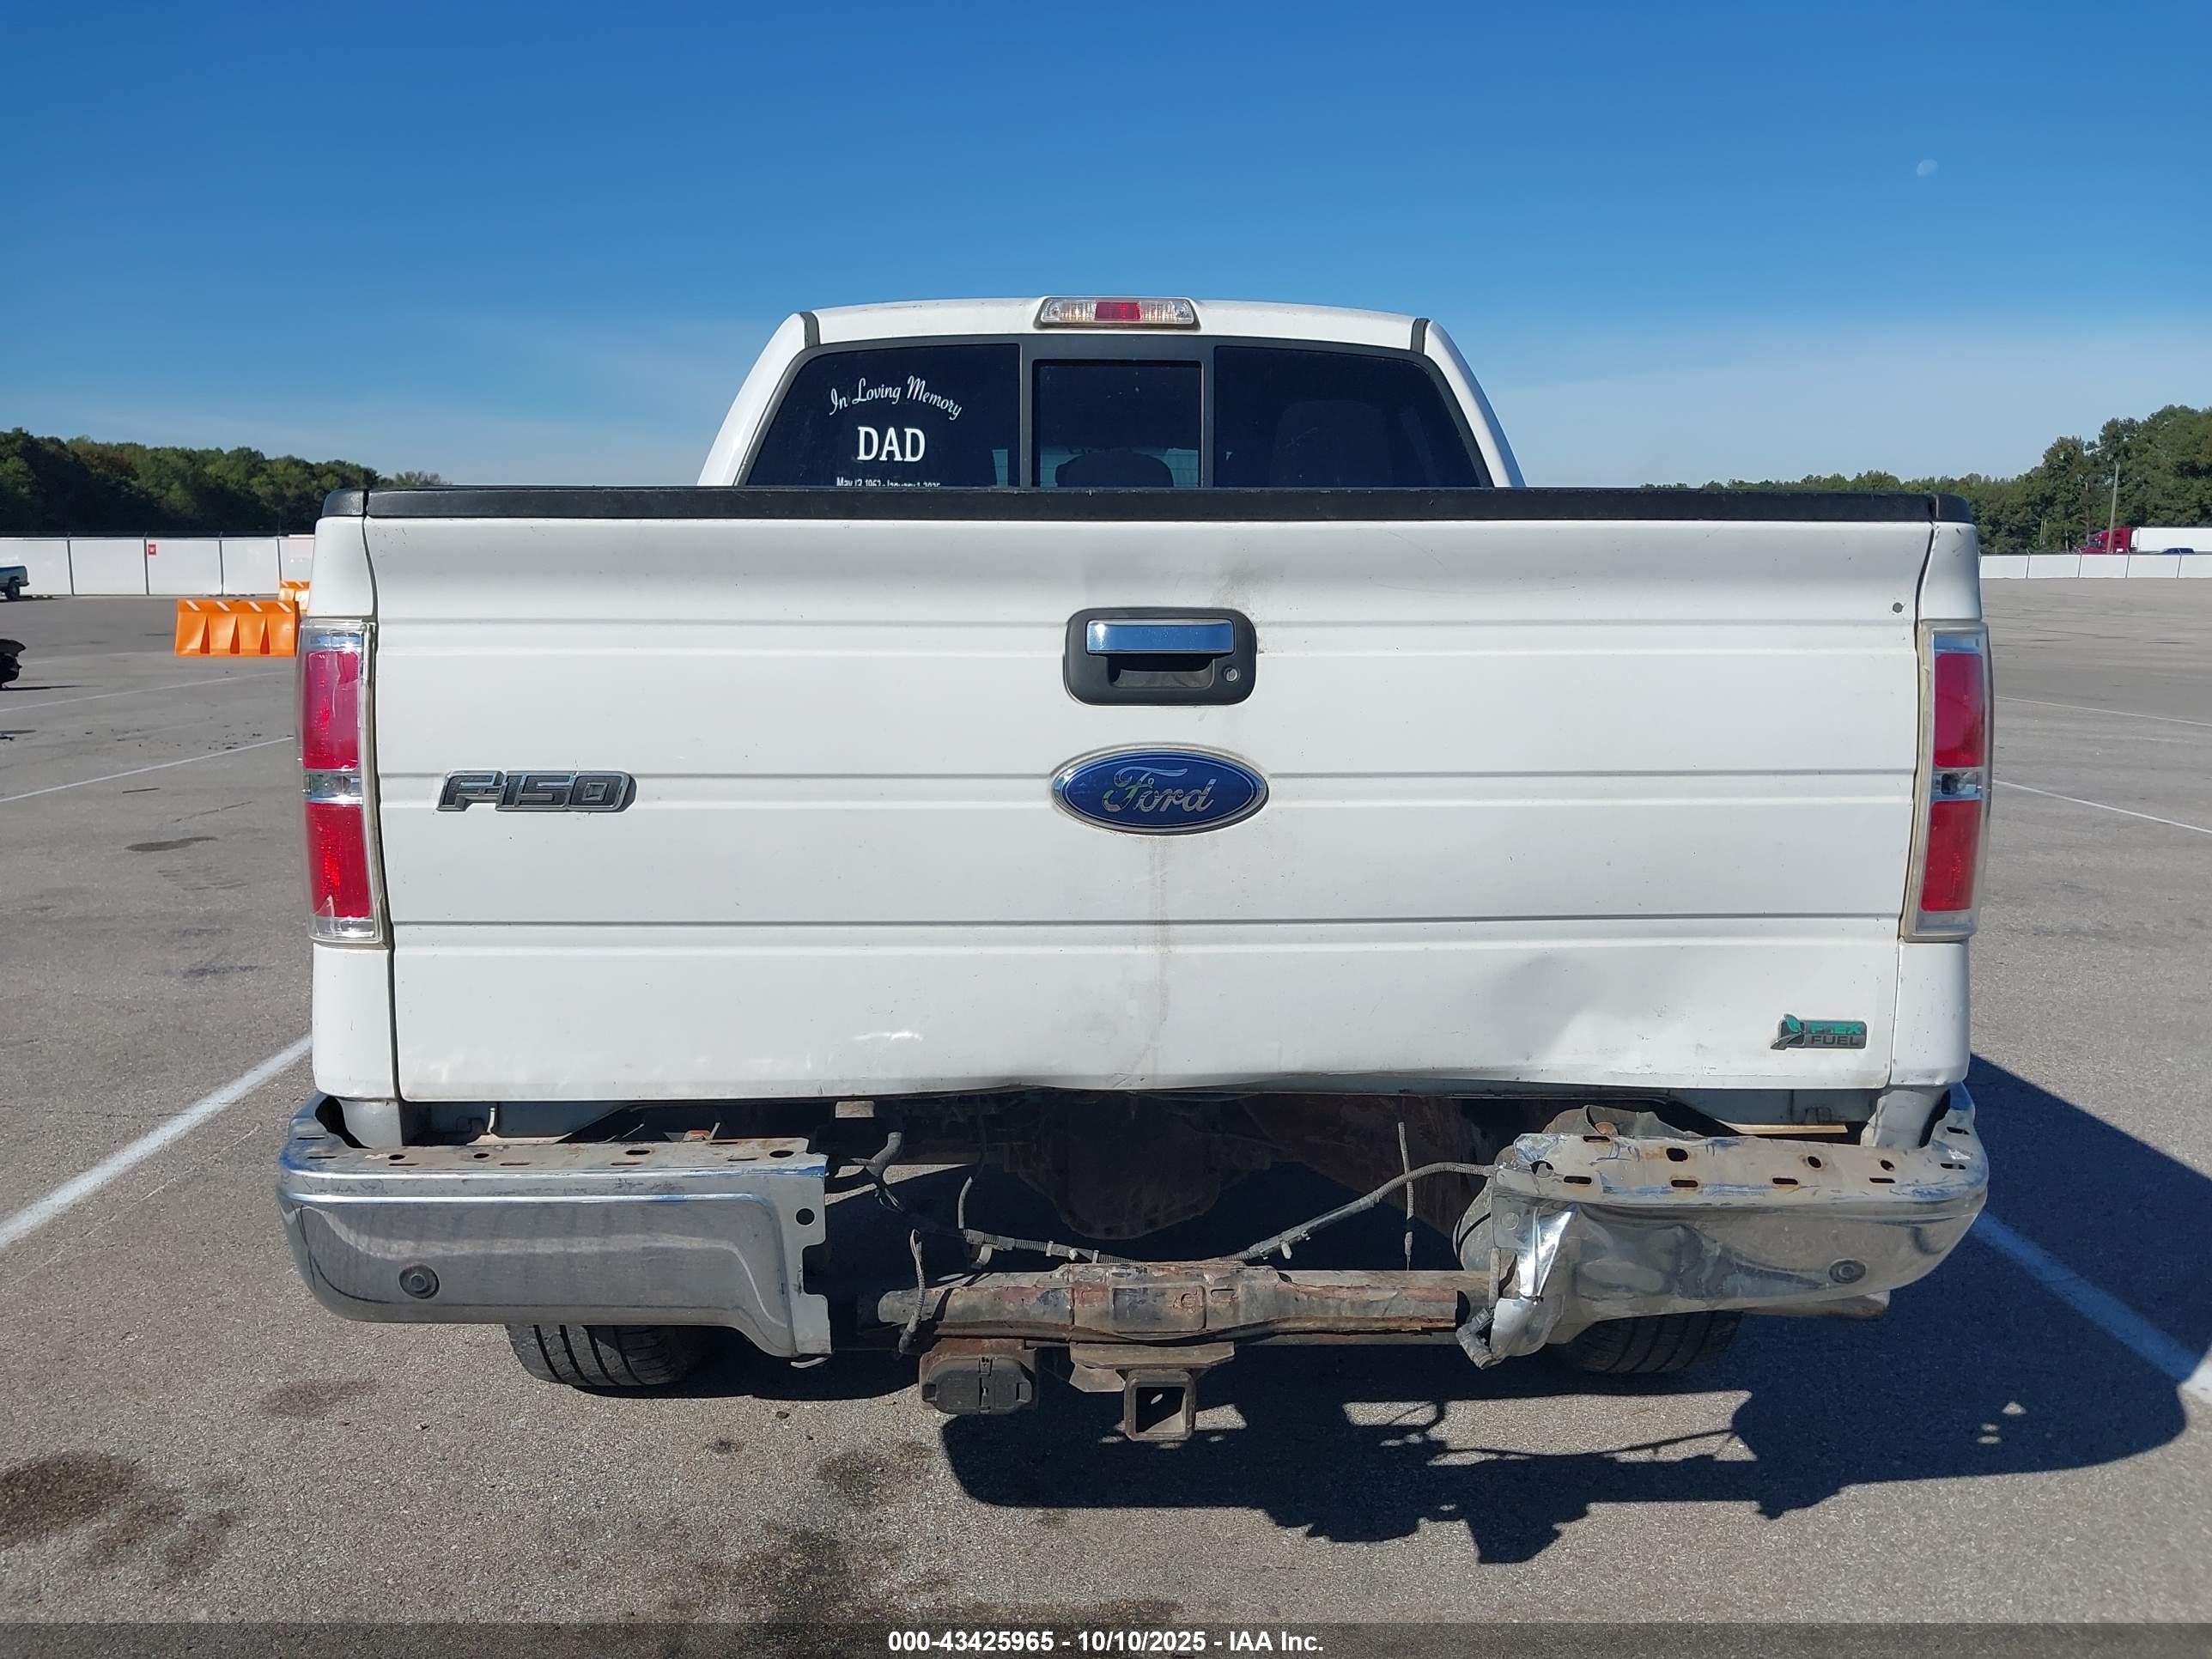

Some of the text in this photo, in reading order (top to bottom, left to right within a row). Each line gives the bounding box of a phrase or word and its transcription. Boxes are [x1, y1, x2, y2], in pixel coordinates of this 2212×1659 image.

[829, 375, 963, 420] In Loving Memory
[857, 426, 927, 462] DAD
[1102, 766, 1218, 812] Ford
[1810, 1035, 1860, 1045] FUEL
